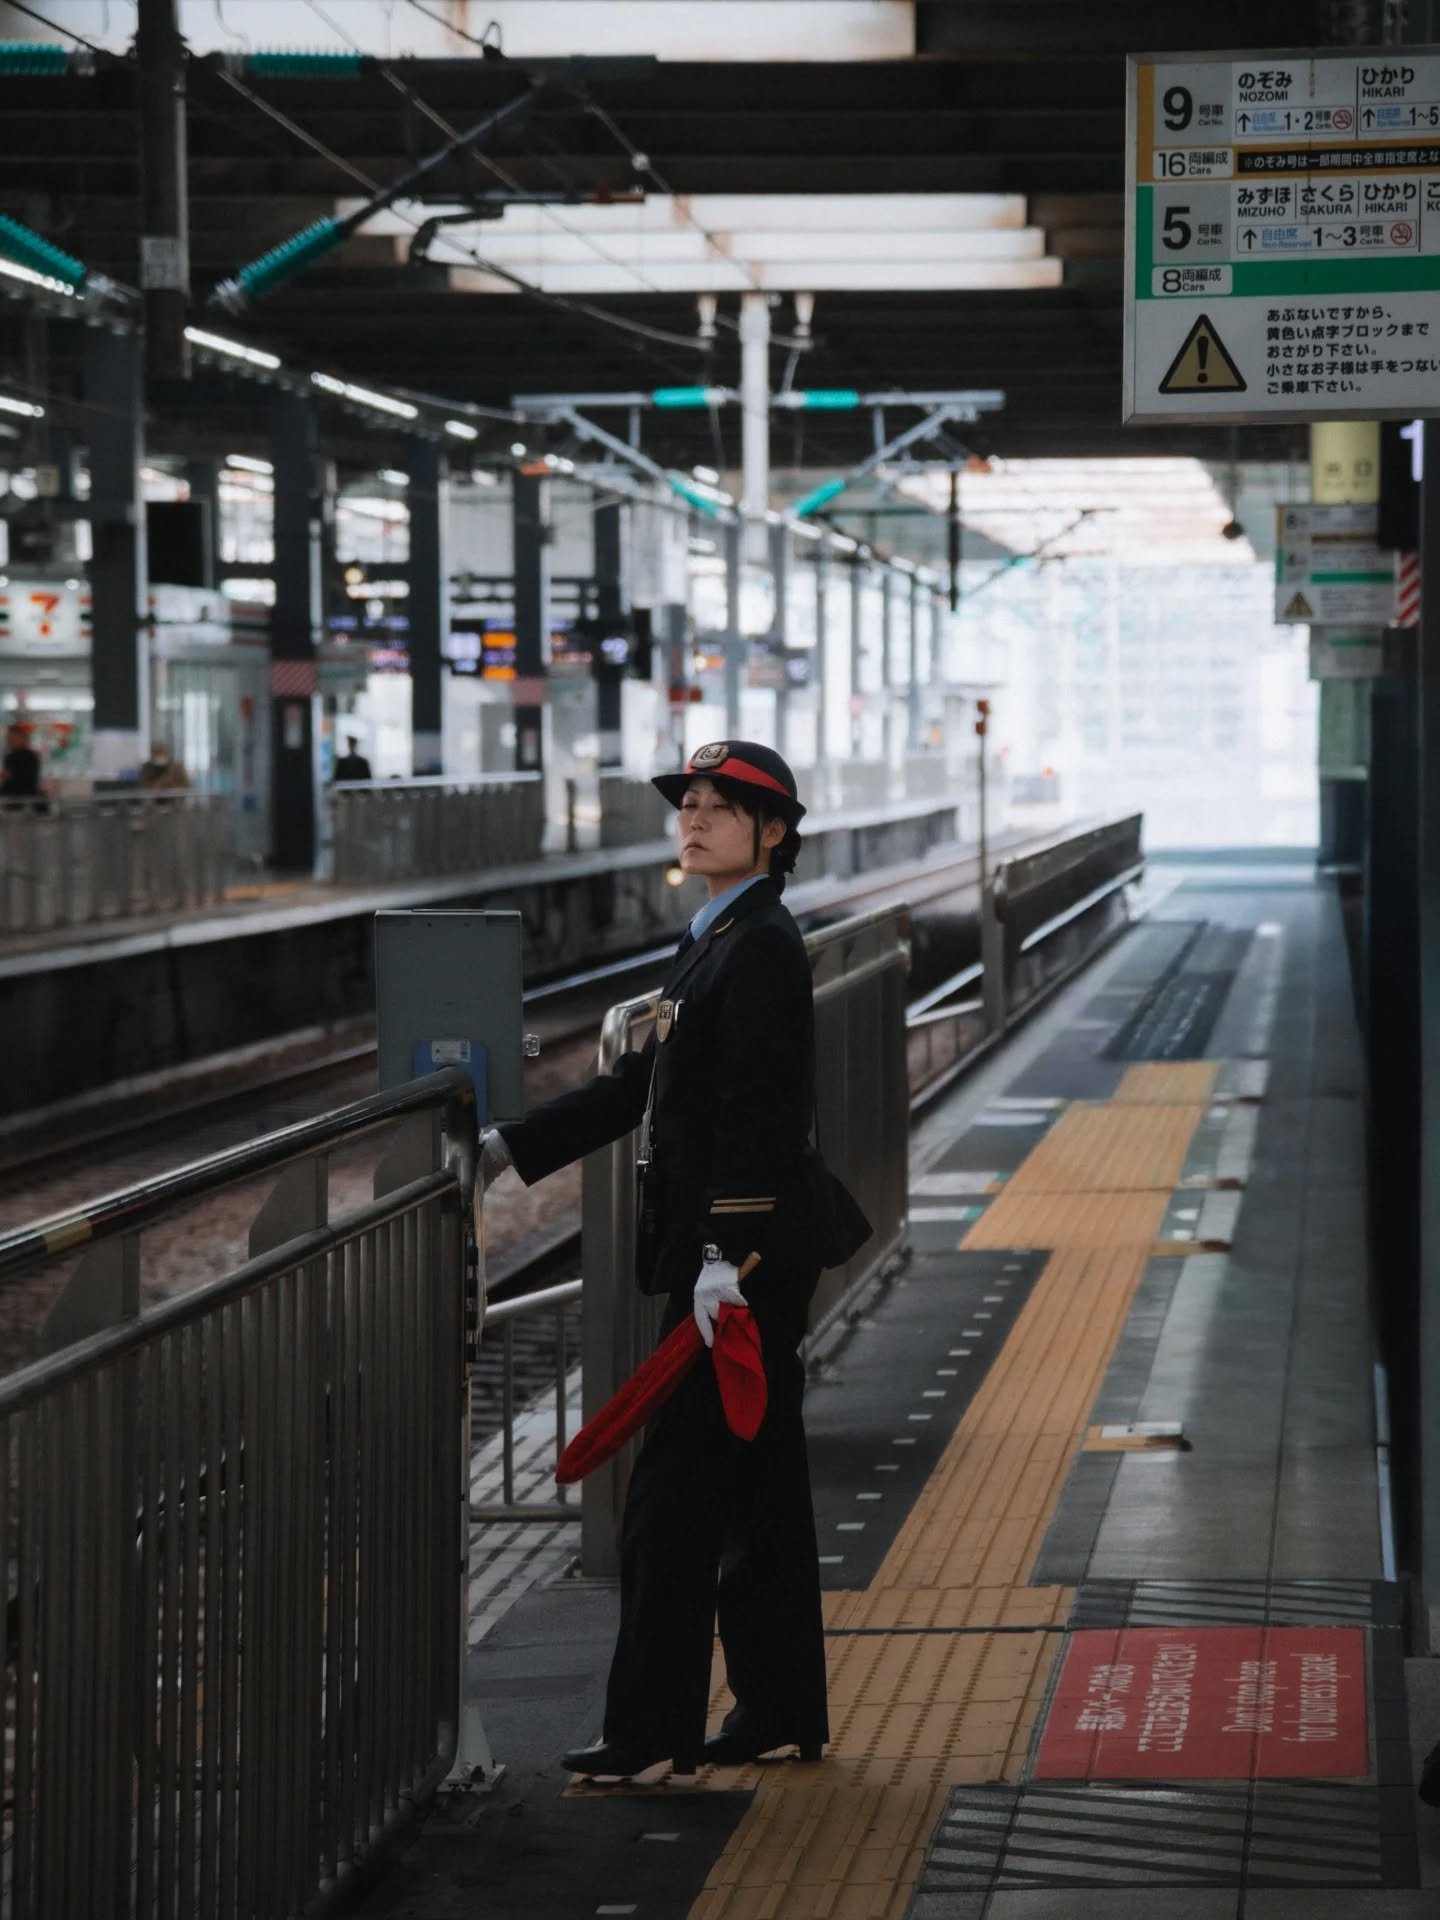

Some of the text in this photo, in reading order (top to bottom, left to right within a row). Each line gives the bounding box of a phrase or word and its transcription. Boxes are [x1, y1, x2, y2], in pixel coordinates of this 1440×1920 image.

[1238, 71, 1293, 90] のぞみ
[1362, 67, 1415, 85] ひかり
[1239, 91, 1288, 102] NOZOMI
[1362, 87, 1405, 98] HIKARI
[1163, 87, 1193, 131] 9
[1158, 152, 1186, 177] 16
[1189, 166, 1212, 175] Cars
[1237, 187, 1291, 205] みずほ
[1301, 184, 1355, 202] さくら
[1364, 183, 1417, 201] ひかり
[1237, 206, 1286, 218] MIZUHO
[1300, 204, 1353, 216] SAKURA
[1365, 202, 1408, 213] HIKARI
[1162, 206, 1192, 250] 5
[1162, 269, 1182, 293] 8
[1182, 283, 1205, 292] Cars
[1266, 306, 1392, 322] あぶないですから、
[1266, 322, 1429, 341] 黄色い点字ブロックまで
[1266, 343, 1377, 359] おさがり下さい。
[1266, 380, 1362, 395] ご乗車下さい。
[1224, 1661, 1278, 1682] here
[1228, 1684, 1288, 1704] stop
[1283, 1684, 1338, 1723] business
[1282, 1725, 1338, 1742] for
